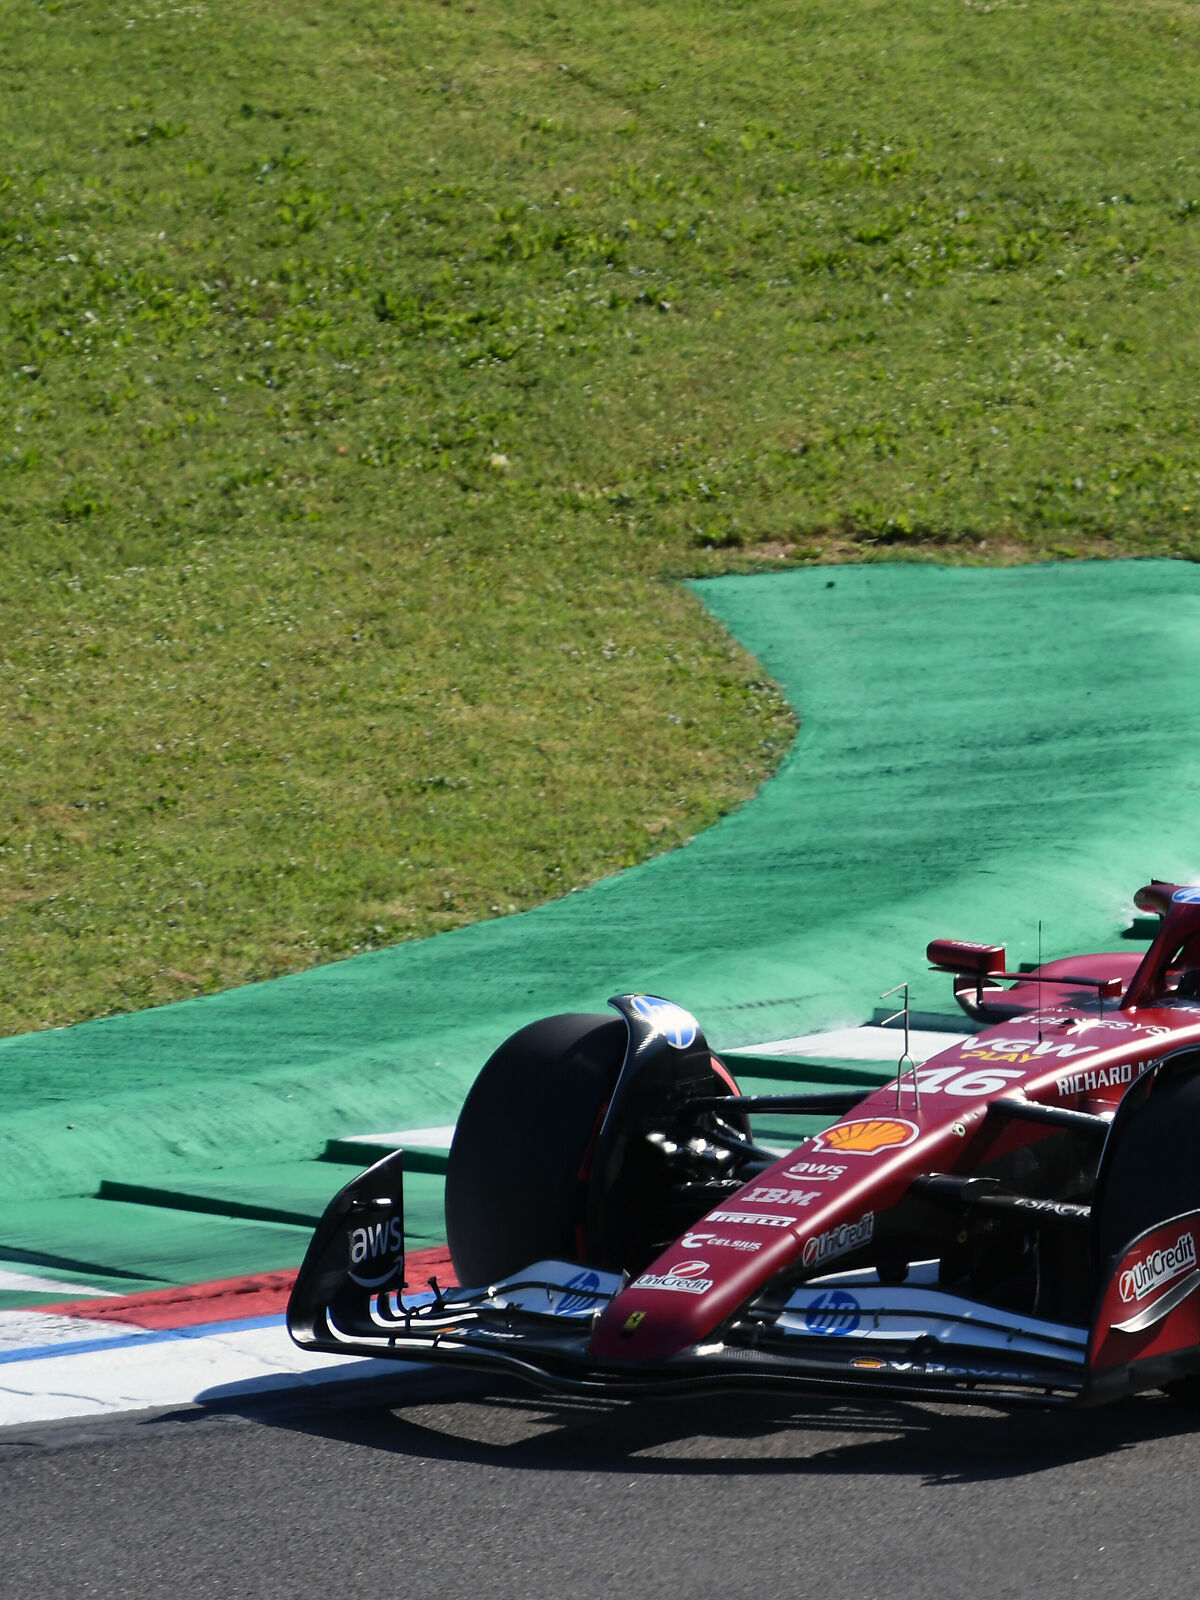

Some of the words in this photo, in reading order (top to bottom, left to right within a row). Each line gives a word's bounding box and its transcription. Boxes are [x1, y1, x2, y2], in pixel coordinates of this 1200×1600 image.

[959, 1050, 1044, 1064] PLAY
[960, 1036, 1100, 1059] VGW
[887, 1066, 1026, 1097] 16
[1056, 1064, 1132, 1097] RICHARD
[789, 1162, 849, 1176] aws
[741, 1187, 823, 1207] IBM
[704, 1211, 798, 1228] PIRELLI
[351, 1216, 402, 1263] aws
[706, 1237, 762, 1250] CELSIUS
[818, 1211, 874, 1257] UniCredit
[1133, 1235, 1194, 1290] UniCredit
[636, 1275, 711, 1291] UniCredit
[806, 1290, 860, 1336] hp
